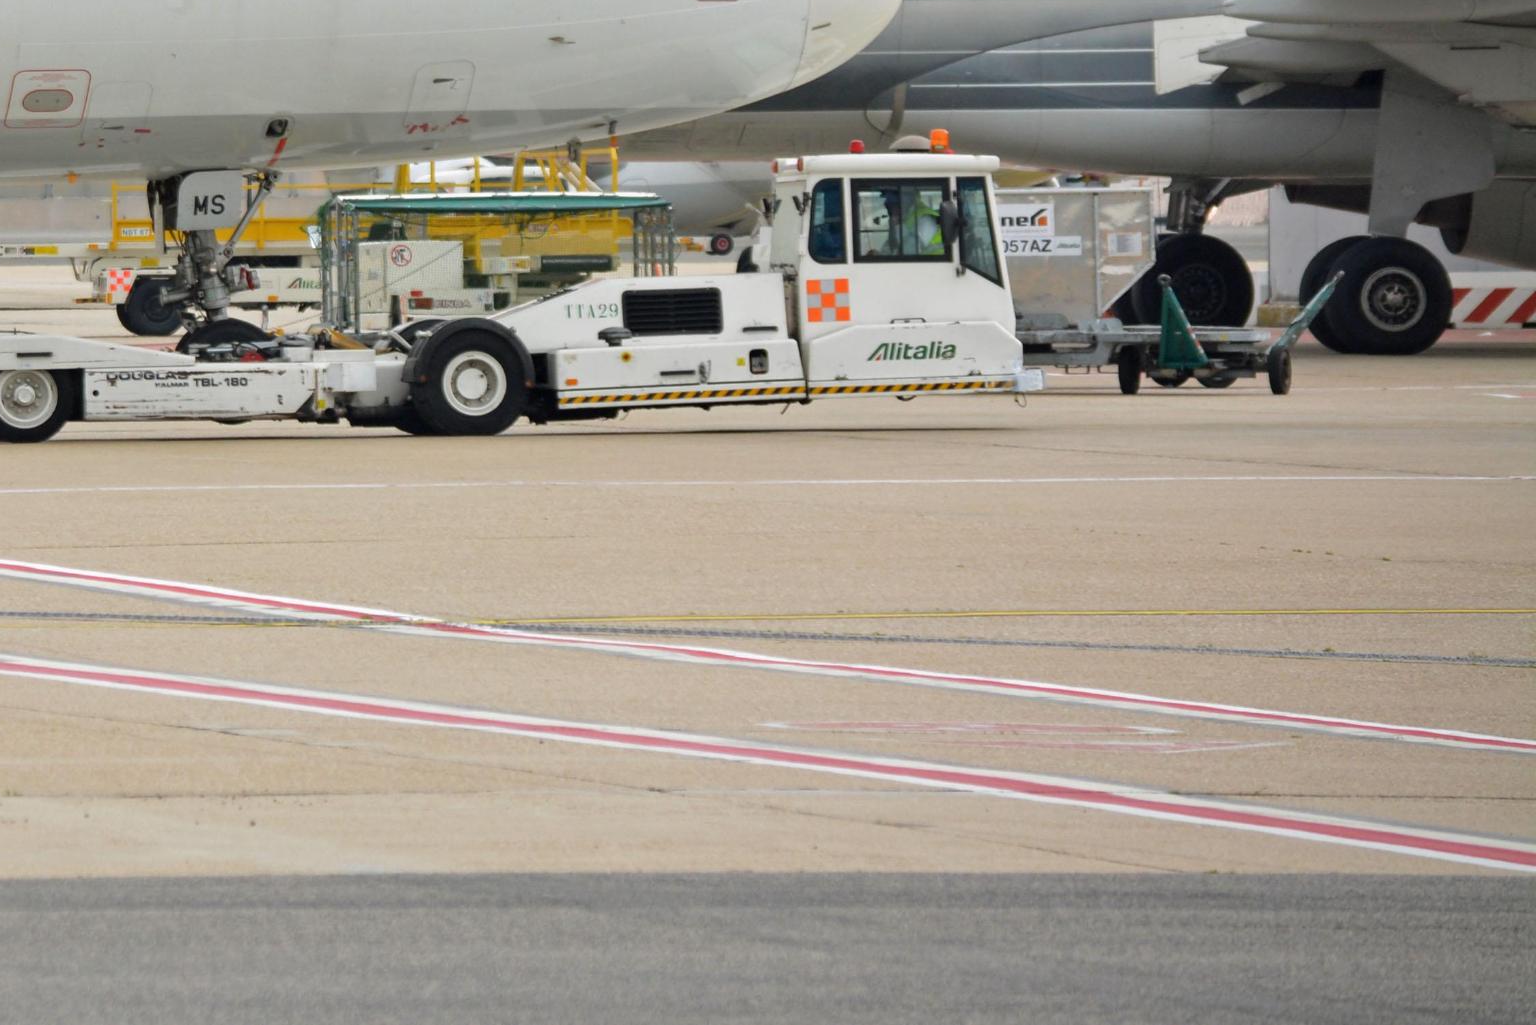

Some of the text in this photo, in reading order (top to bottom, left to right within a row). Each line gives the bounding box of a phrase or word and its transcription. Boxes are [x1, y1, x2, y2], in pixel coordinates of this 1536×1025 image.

[193, 194, 226, 216] MS
[565, 303, 619, 319] TTA29
[867, 341, 957, 361] Alitalia
[106, 370, 189, 381] DOUGLAS
